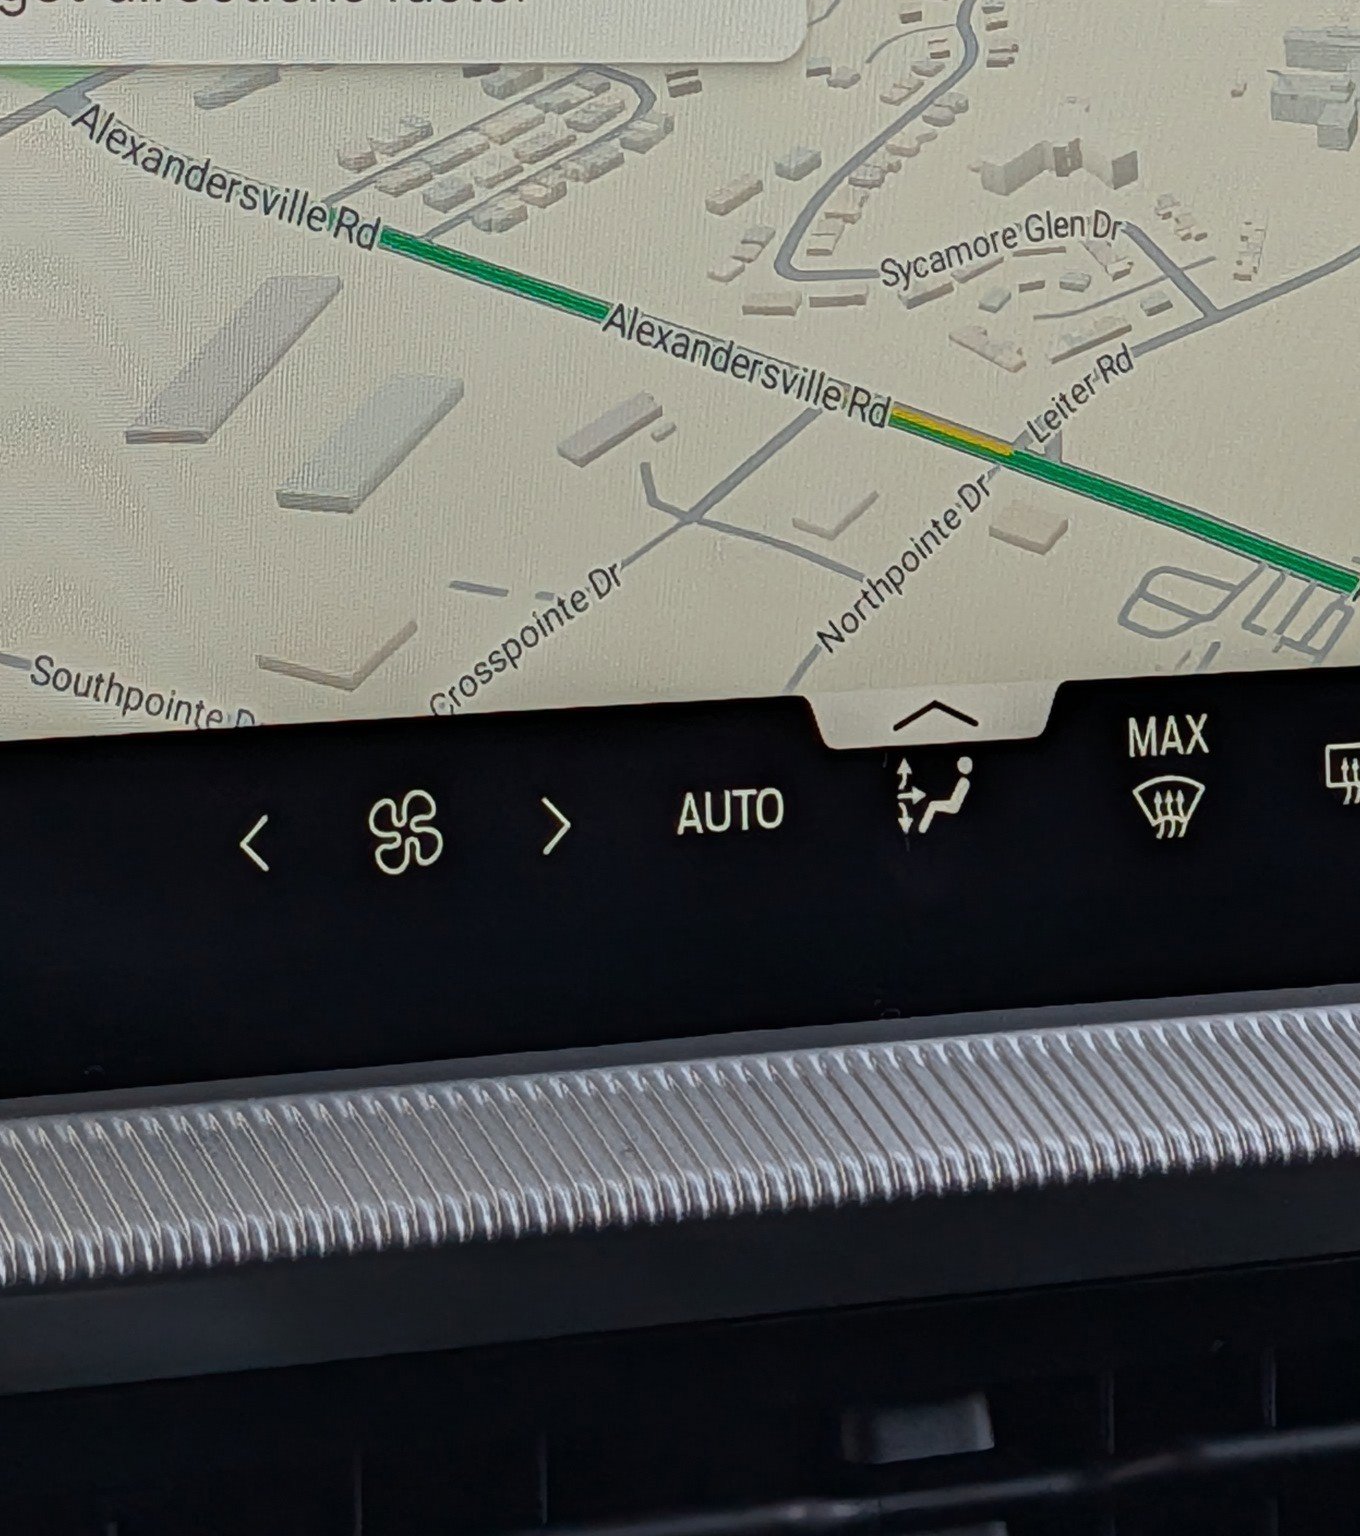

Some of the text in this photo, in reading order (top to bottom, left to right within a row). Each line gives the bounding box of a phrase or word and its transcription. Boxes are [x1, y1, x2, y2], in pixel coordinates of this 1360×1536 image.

[71, 104, 381, 251] Alexandersville Rd
[881, 209, 1122, 291] Sycamore Glen Dr
[602, 303, 892, 429] Alexandersville Rd
[1026, 342, 1134, 444] Leiter Rd
[816, 474, 991, 653] Northpointe Dr
[430, 563, 621, 715] Crosspointe Dr
[31, 655, 256, 730] Southpointe D
[1128, 713, 1209, 757] MAX
[677, 787, 785, 835] AUTO
